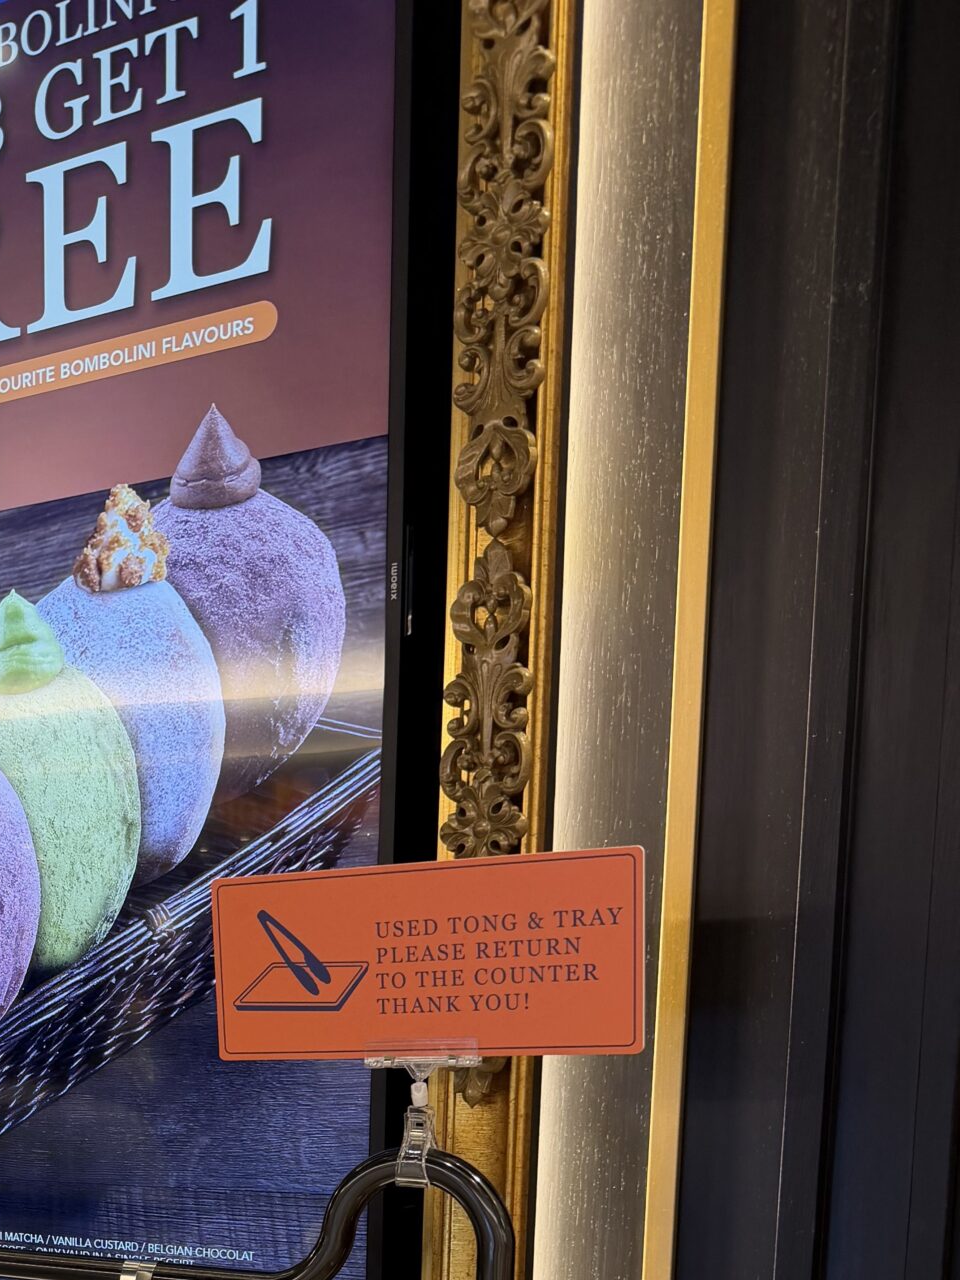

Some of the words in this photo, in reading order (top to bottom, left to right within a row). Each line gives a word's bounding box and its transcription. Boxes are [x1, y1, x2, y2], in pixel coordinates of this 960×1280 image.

[34, 16, 198, 141] GET
[229, 0, 268, 80] 1
[60, 341, 157, 380] BOMBOLINI
[162, 316, 255, 355] FLAVOURS
[375, 918, 438, 939] USED
[448, 912, 518, 935] TONG
[527, 911, 544, 930] &
[553, 906, 623, 928] TRAY
[376, 943, 466, 964] PLEASE
[475, 936, 581, 960] RETURN
[376, 972, 406, 990] TO
[415, 969, 464, 988] THE
[474, 963, 599, 986] COUNTER
[376, 995, 461, 1015] THANK
[468, 992, 530, 1012] YOU!
[4, 1231, 45, 1244] MATCHA
[51, 1235, 93, 1249] VANILLA
[93, 1238, 139, 1253] CUSTARD
[147, 1243, 193, 1257] BELGIAN
[195, 1246, 256, 1262] CHOCOLAT
